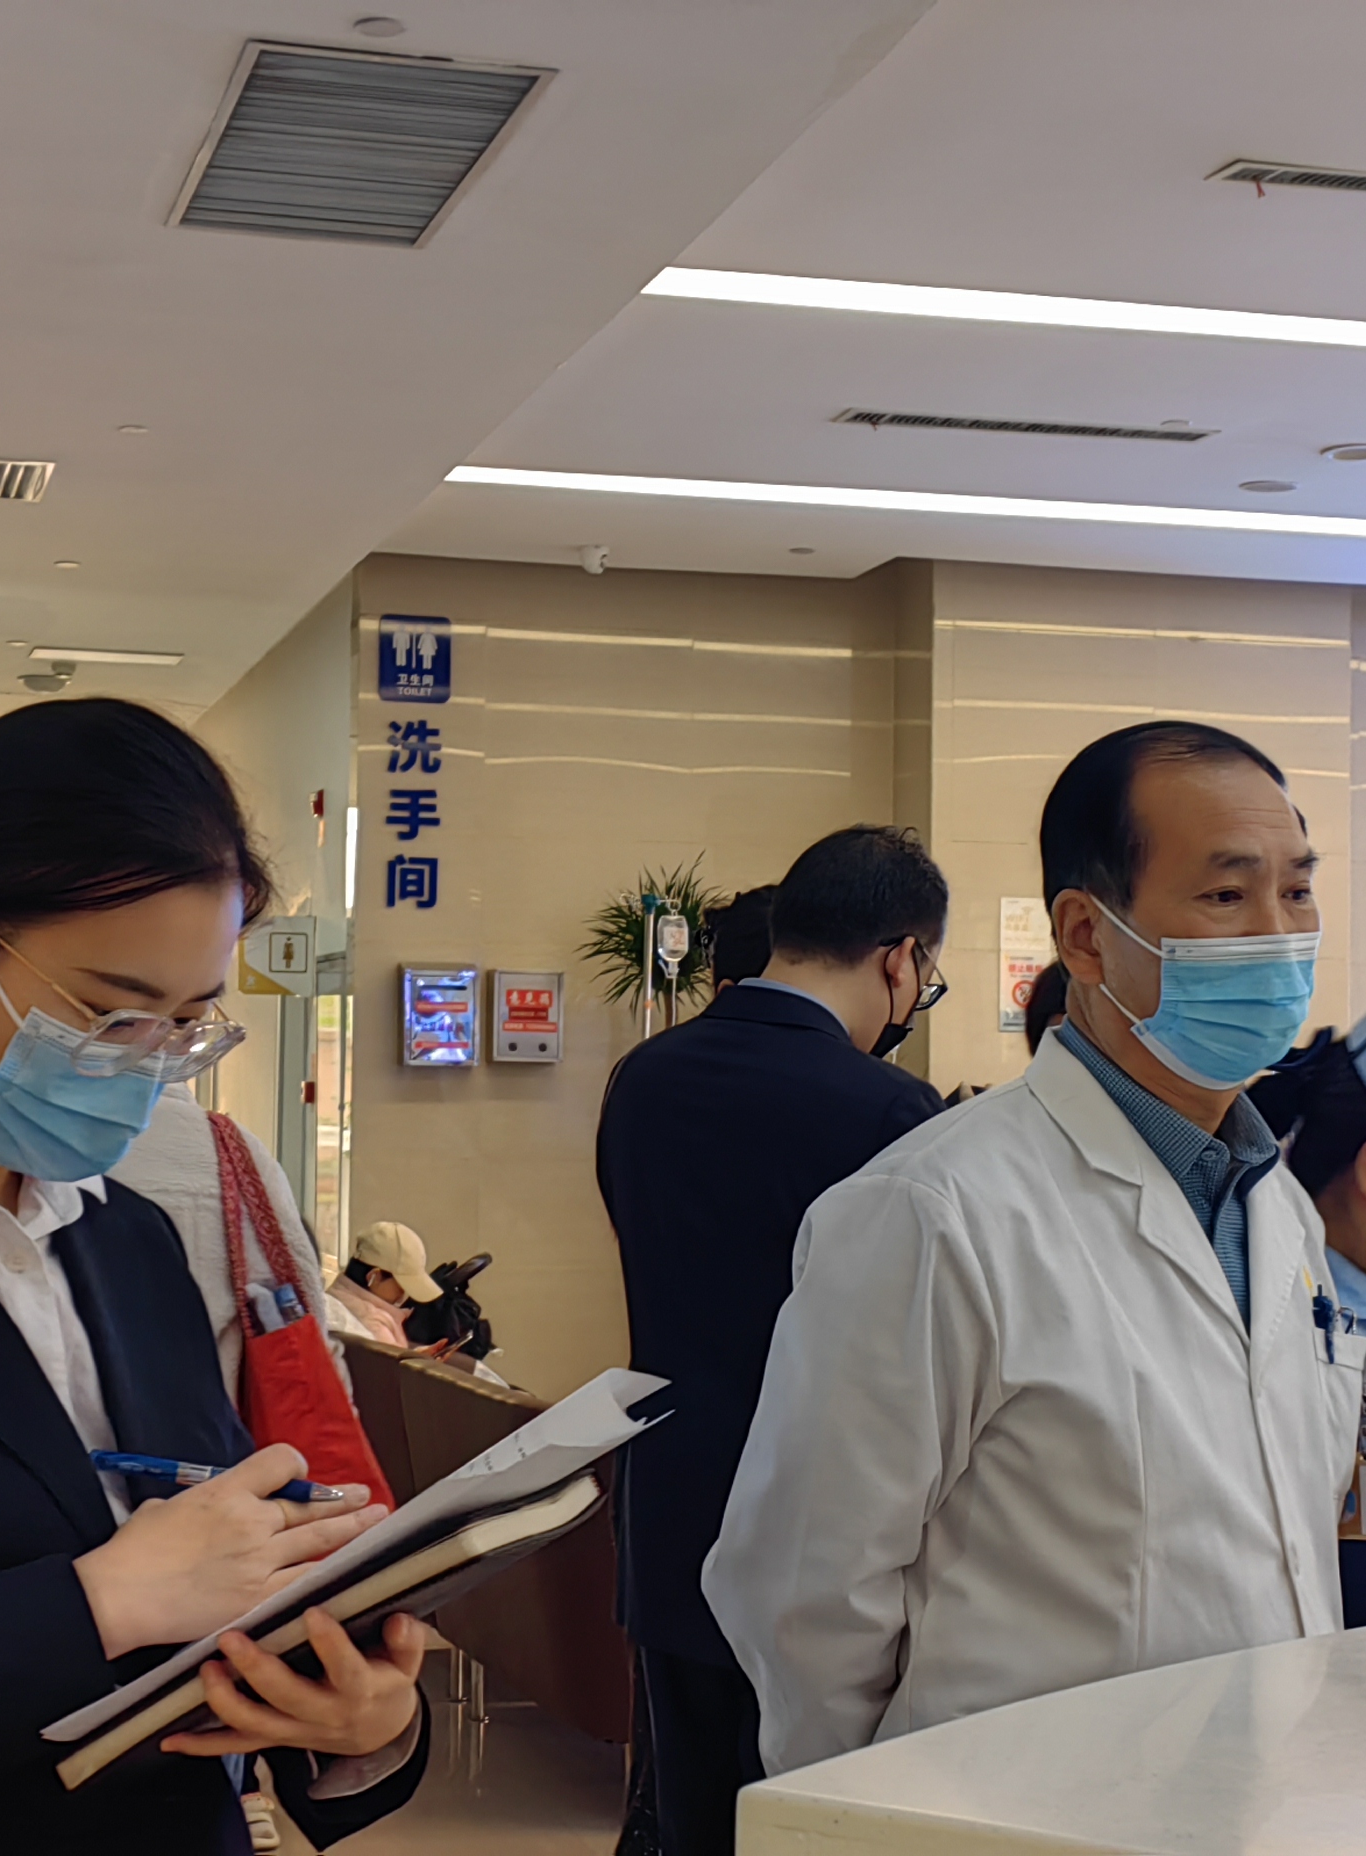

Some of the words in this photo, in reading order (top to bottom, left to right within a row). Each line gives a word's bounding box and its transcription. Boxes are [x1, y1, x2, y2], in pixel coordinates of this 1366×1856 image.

[397, 673, 434, 687] 卫生间
[397, 686, 432, 697] TOILET
[385, 719, 442, 910] 洗手间
